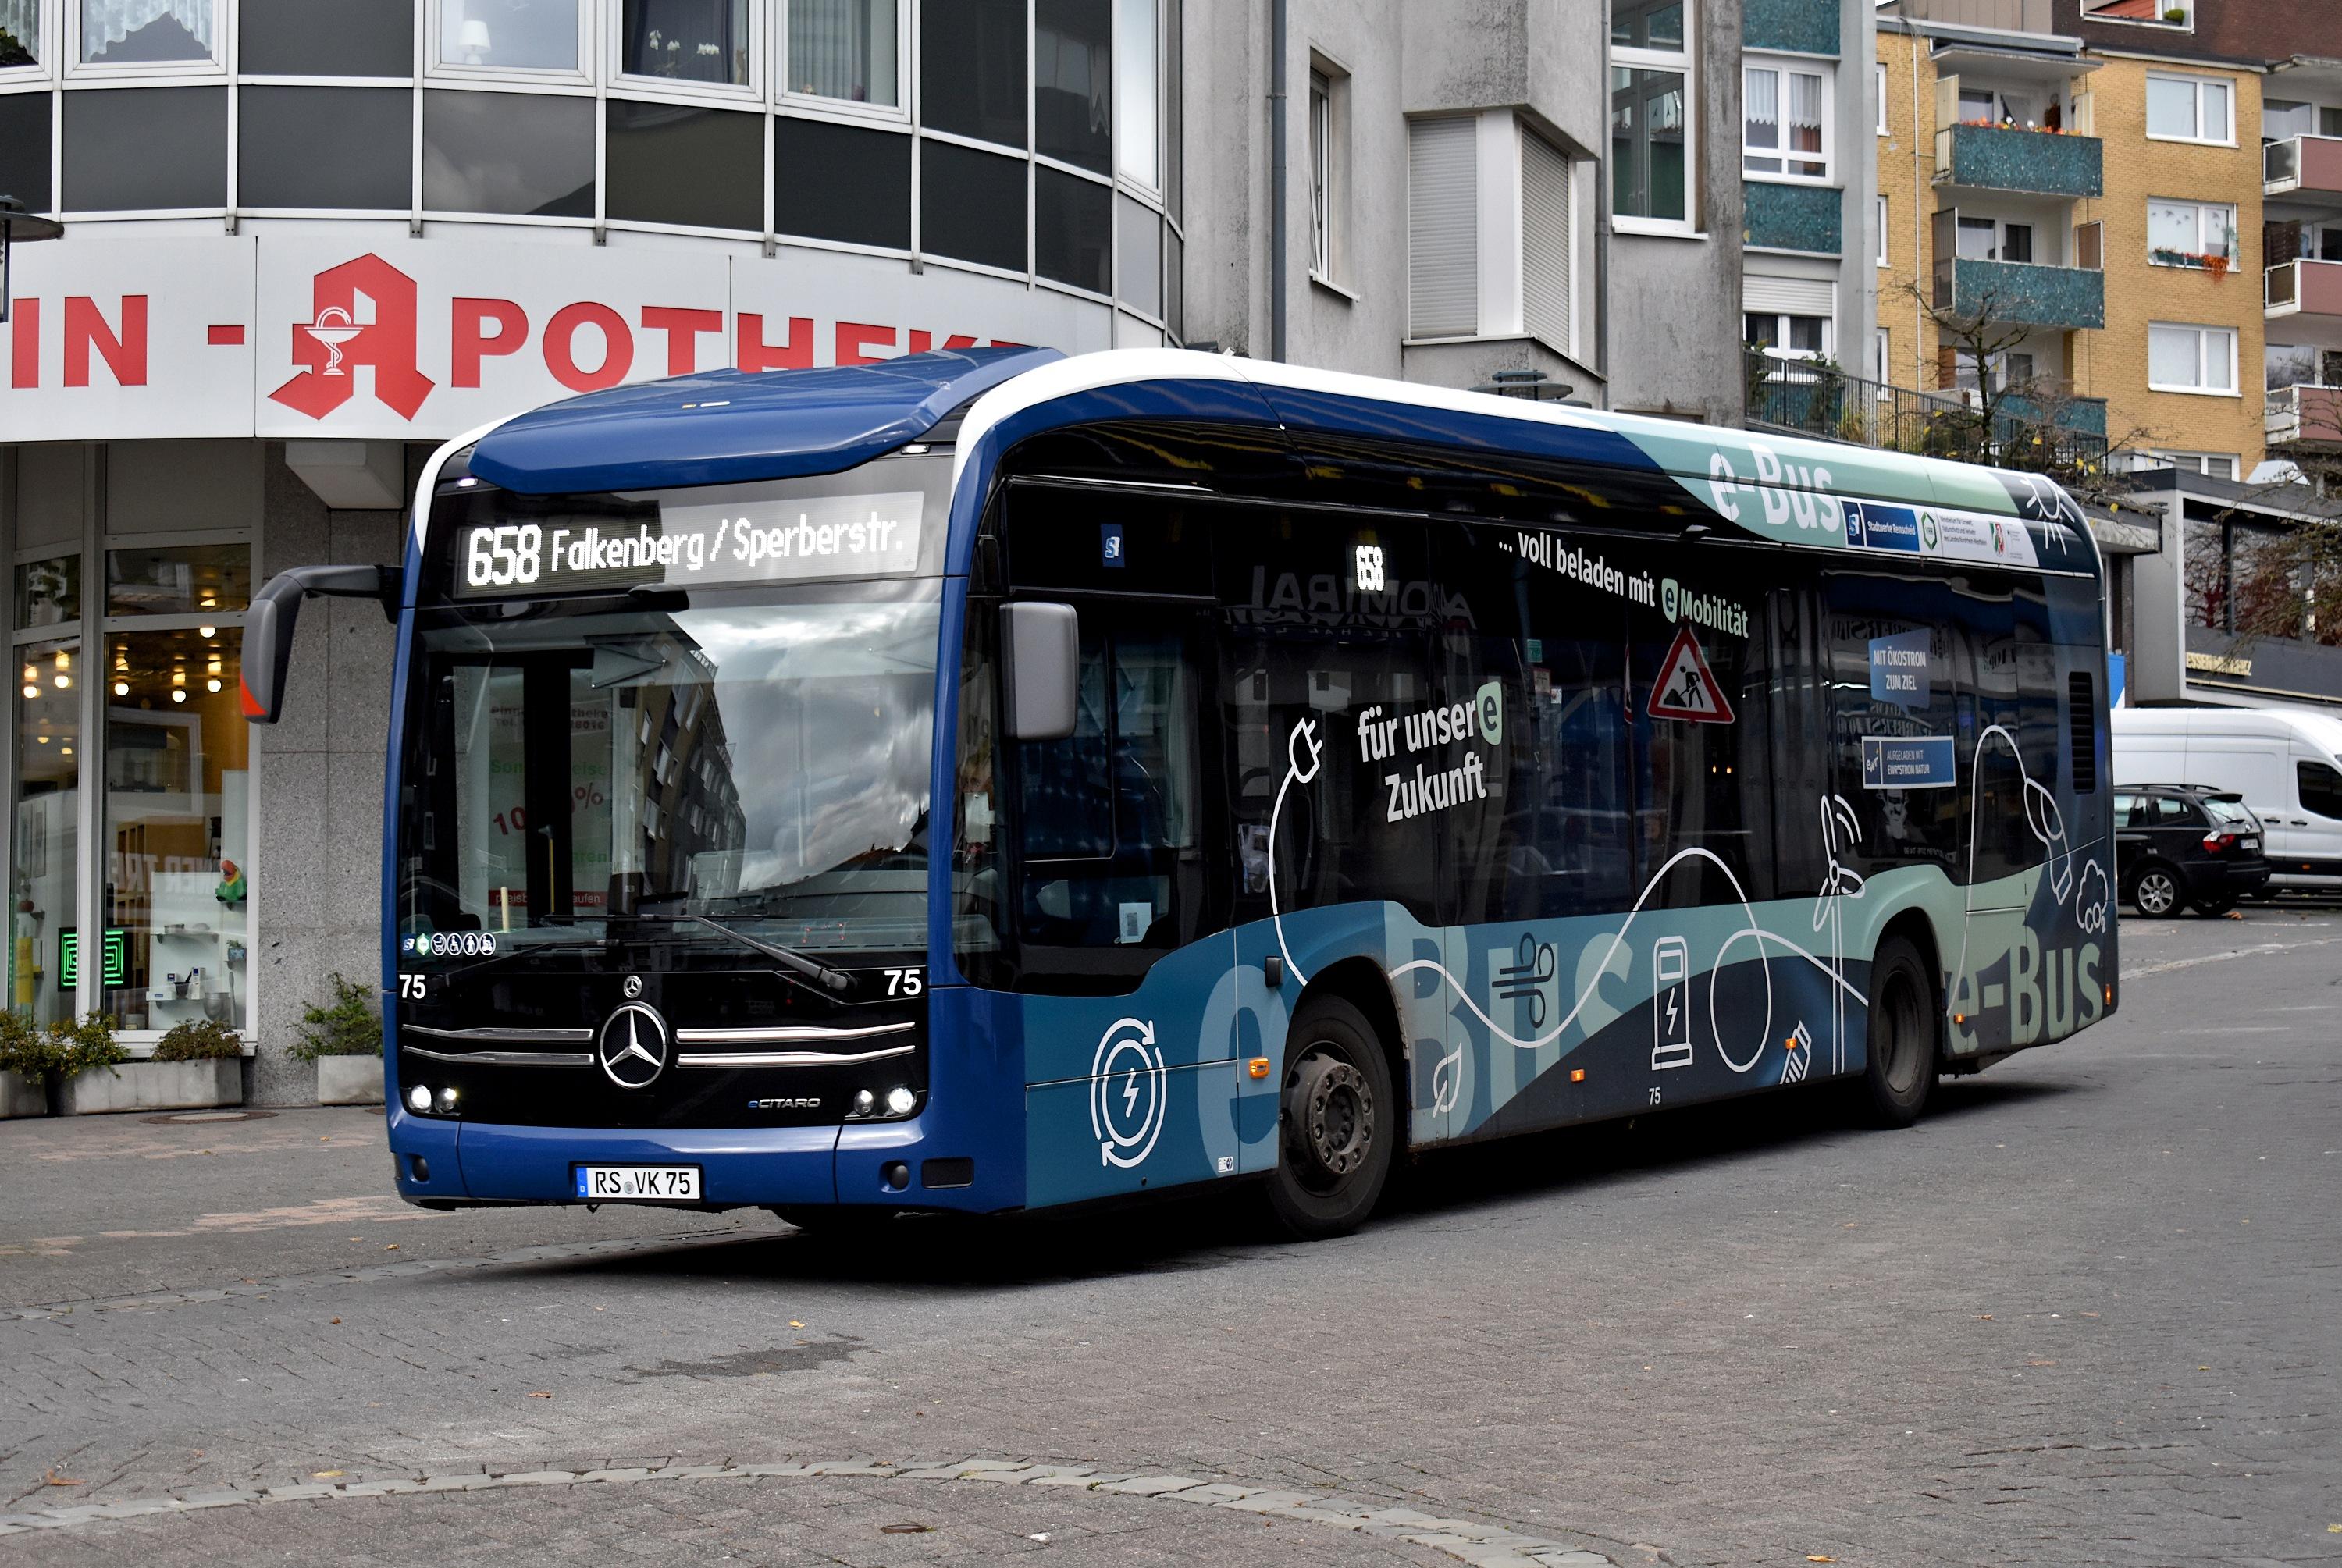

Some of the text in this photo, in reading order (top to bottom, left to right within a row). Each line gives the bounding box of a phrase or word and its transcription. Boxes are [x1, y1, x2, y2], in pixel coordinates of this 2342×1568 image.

[269, 253, 1030, 421] APOTHE
[1709, 443, 1841, 532] e-Bus
[1867, 521, 1916, 536] Stadtwerke Remscheid
[467, 524, 543, 586] 658
[552, 525, 704, 571] Falkenberg
[732, 511, 904, 567] Sperberstr.
[1356, 546, 1386, 591] 658
[1518, 532, 1551, 568] voll
[1556, 539, 1624, 596] beladen
[1628, 571, 1655, 607] mit
[1874, 646, 1926, 667] MIT ÖKOSTROM
[1885, 675, 1917, 690] ZUM ZIEL
[1357, 695, 1497, 763] für unsere
[1887, 749, 1924, 761] AUFGELADEN MIT
[1915, 764, 1930, 774] NATUR
[1385, 751, 1487, 823] Zukunft
[398, 973, 426, 999] 75
[884, 969, 922, 995] 75
[747, 1098, 821, 1108] eCITARO
[1648, 1087, 1661, 1105] 75
[595, 1171, 690, 1195] RS VK 75
